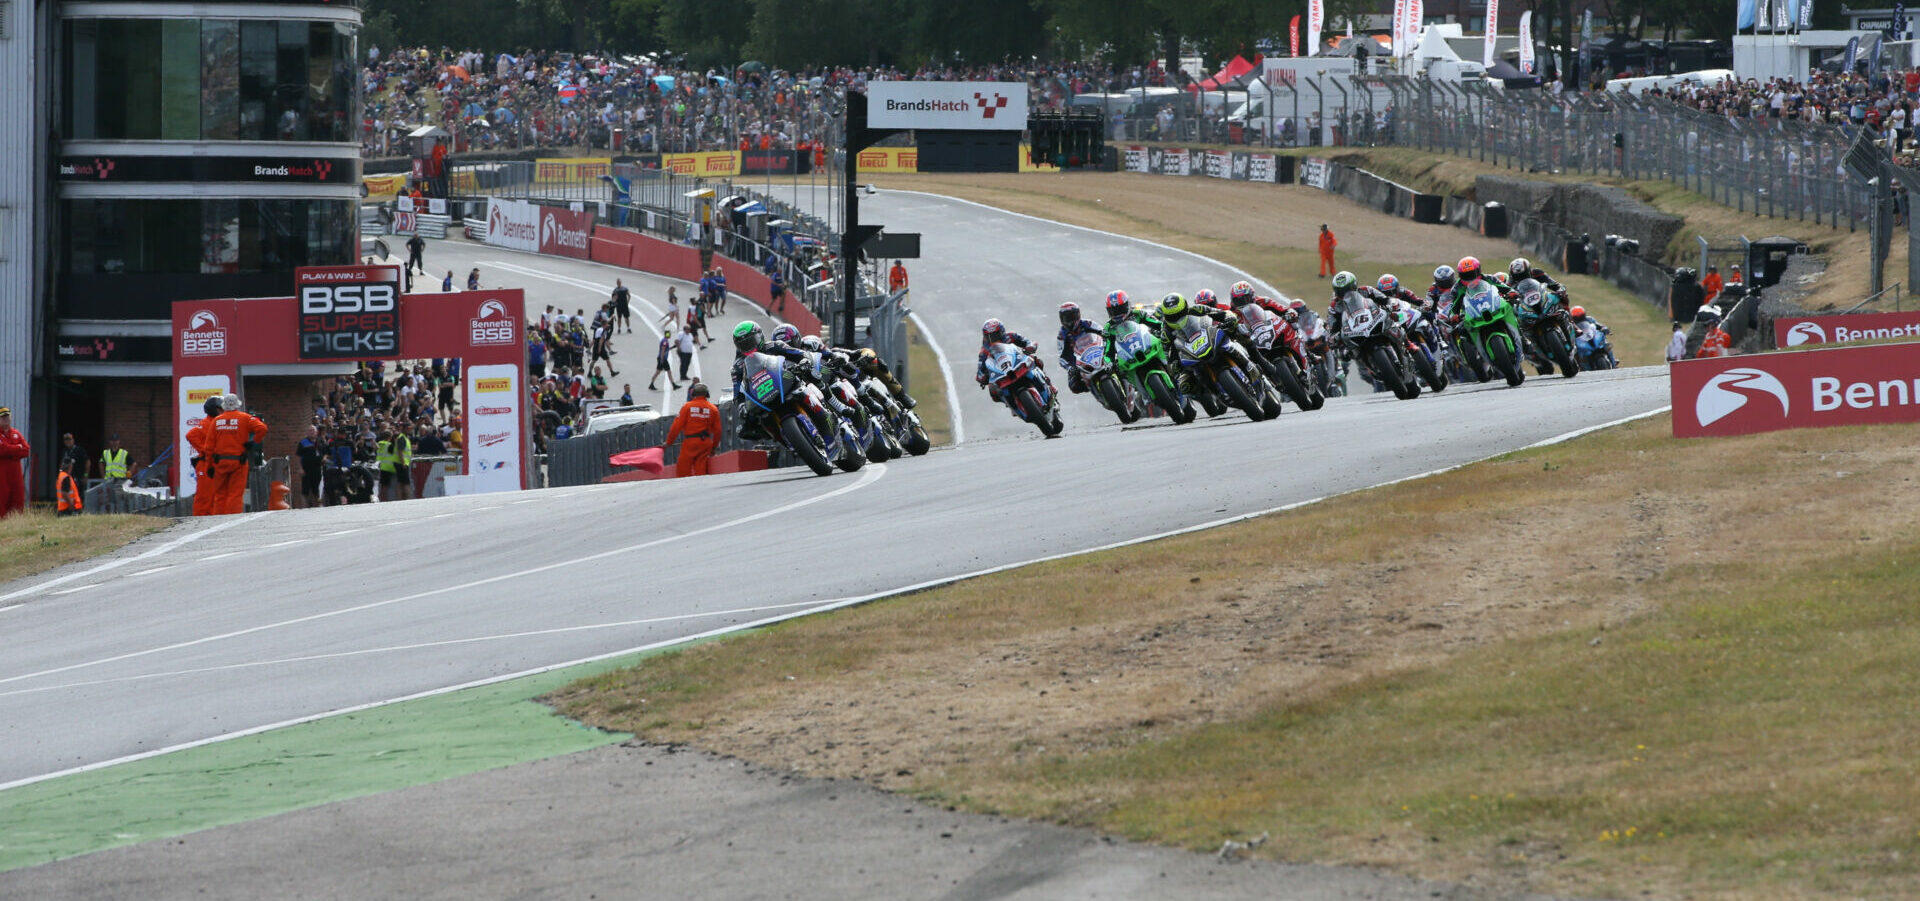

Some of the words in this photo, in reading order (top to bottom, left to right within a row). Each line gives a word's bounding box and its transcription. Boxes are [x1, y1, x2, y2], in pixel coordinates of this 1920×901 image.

[887, 99, 969, 111] BrandsHatch
[859, 152, 888, 168] PIRELLI
[254, 165, 313, 176] BrandsHatch
[504, 216, 535, 241] Bennetts
[558, 224, 587, 249] Bennetts
[303, 285, 394, 314] BSB
[303, 313, 394, 332] SUPER
[472, 320, 513, 328] Bennetts
[183, 331, 225, 340] Bennetts
[303, 331, 395, 352] PICKS
[472, 328, 513, 341] BSB
[183, 338, 225, 351] BSB
[756, 378, 775, 400] 22
